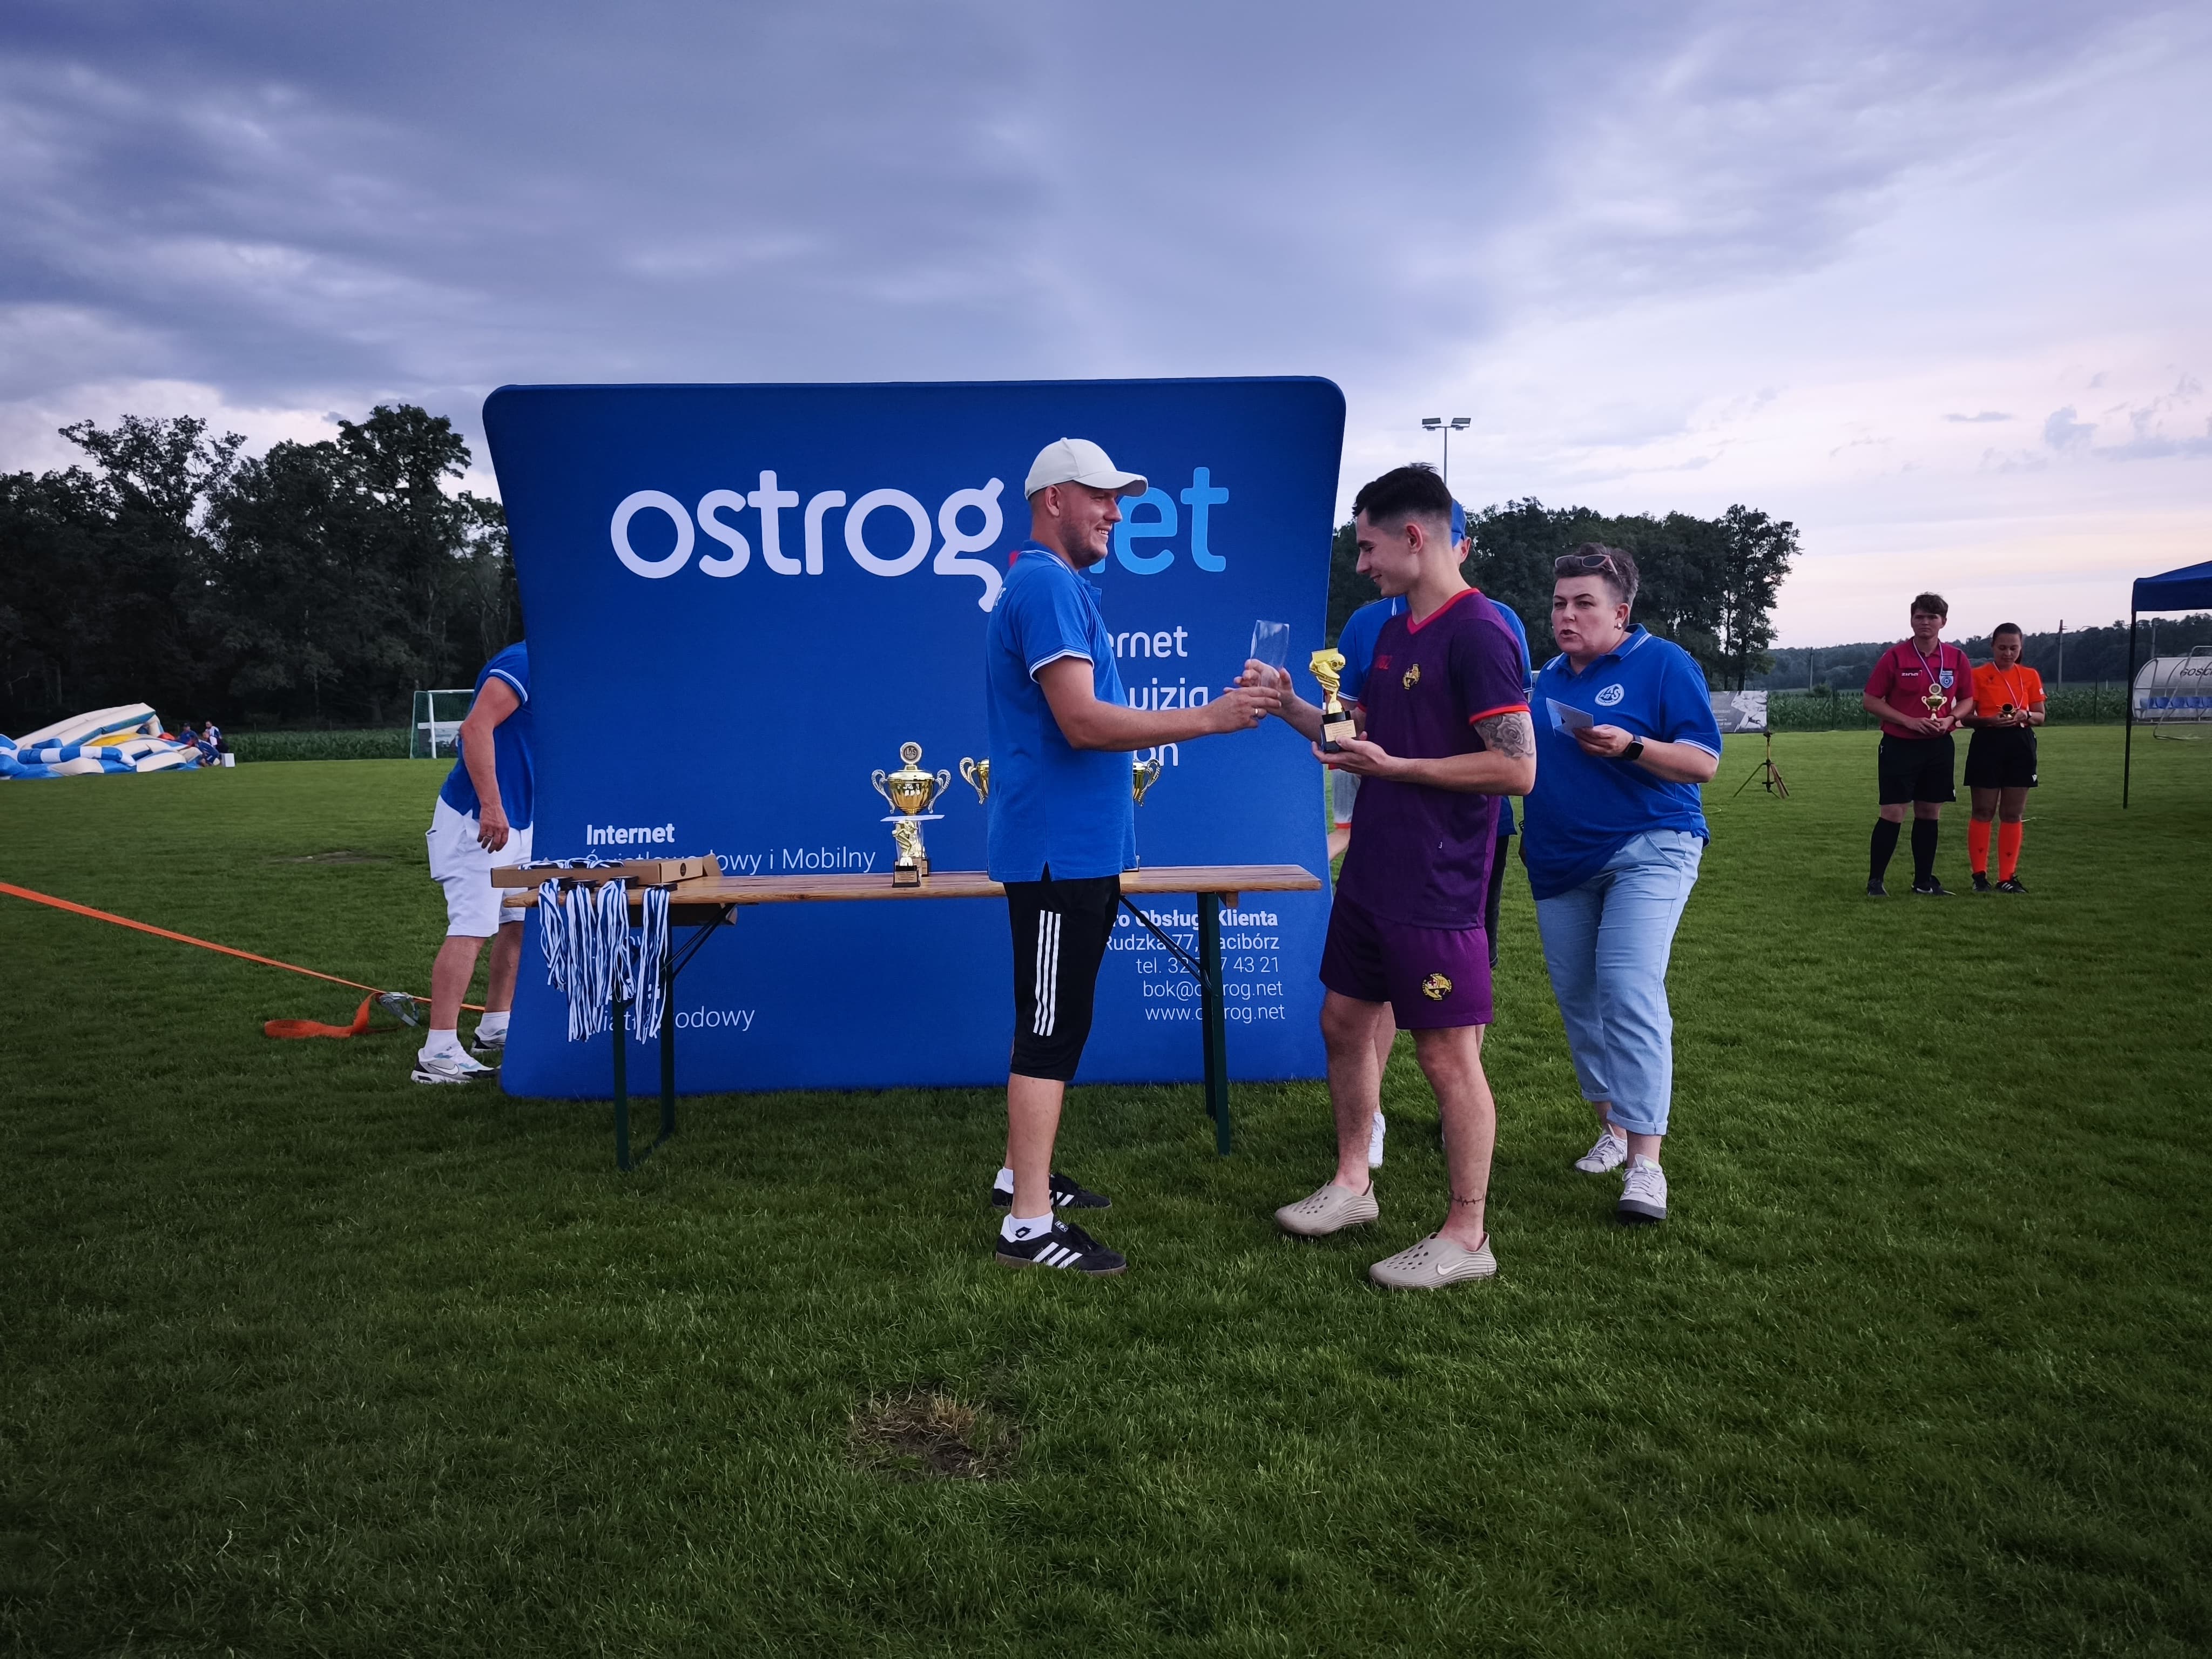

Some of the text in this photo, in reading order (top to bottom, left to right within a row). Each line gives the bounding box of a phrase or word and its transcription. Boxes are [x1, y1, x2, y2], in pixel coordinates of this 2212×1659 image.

[611, 467, 1229, 612] ostroget
[586, 823, 675, 845] Internet
[770, 848, 774, 869] i
[783, 846, 876, 873] Mobilny
[1219, 933, 1280, 950] acibórz
[1136, 957, 1162, 974] tel.
[1233, 956, 1255, 973] 43
[1259, 956, 1278, 973] 21
[1143, 980, 1284, 1001] bok@orog.net
[1145, 1004, 1286, 1024] www.orog.net
